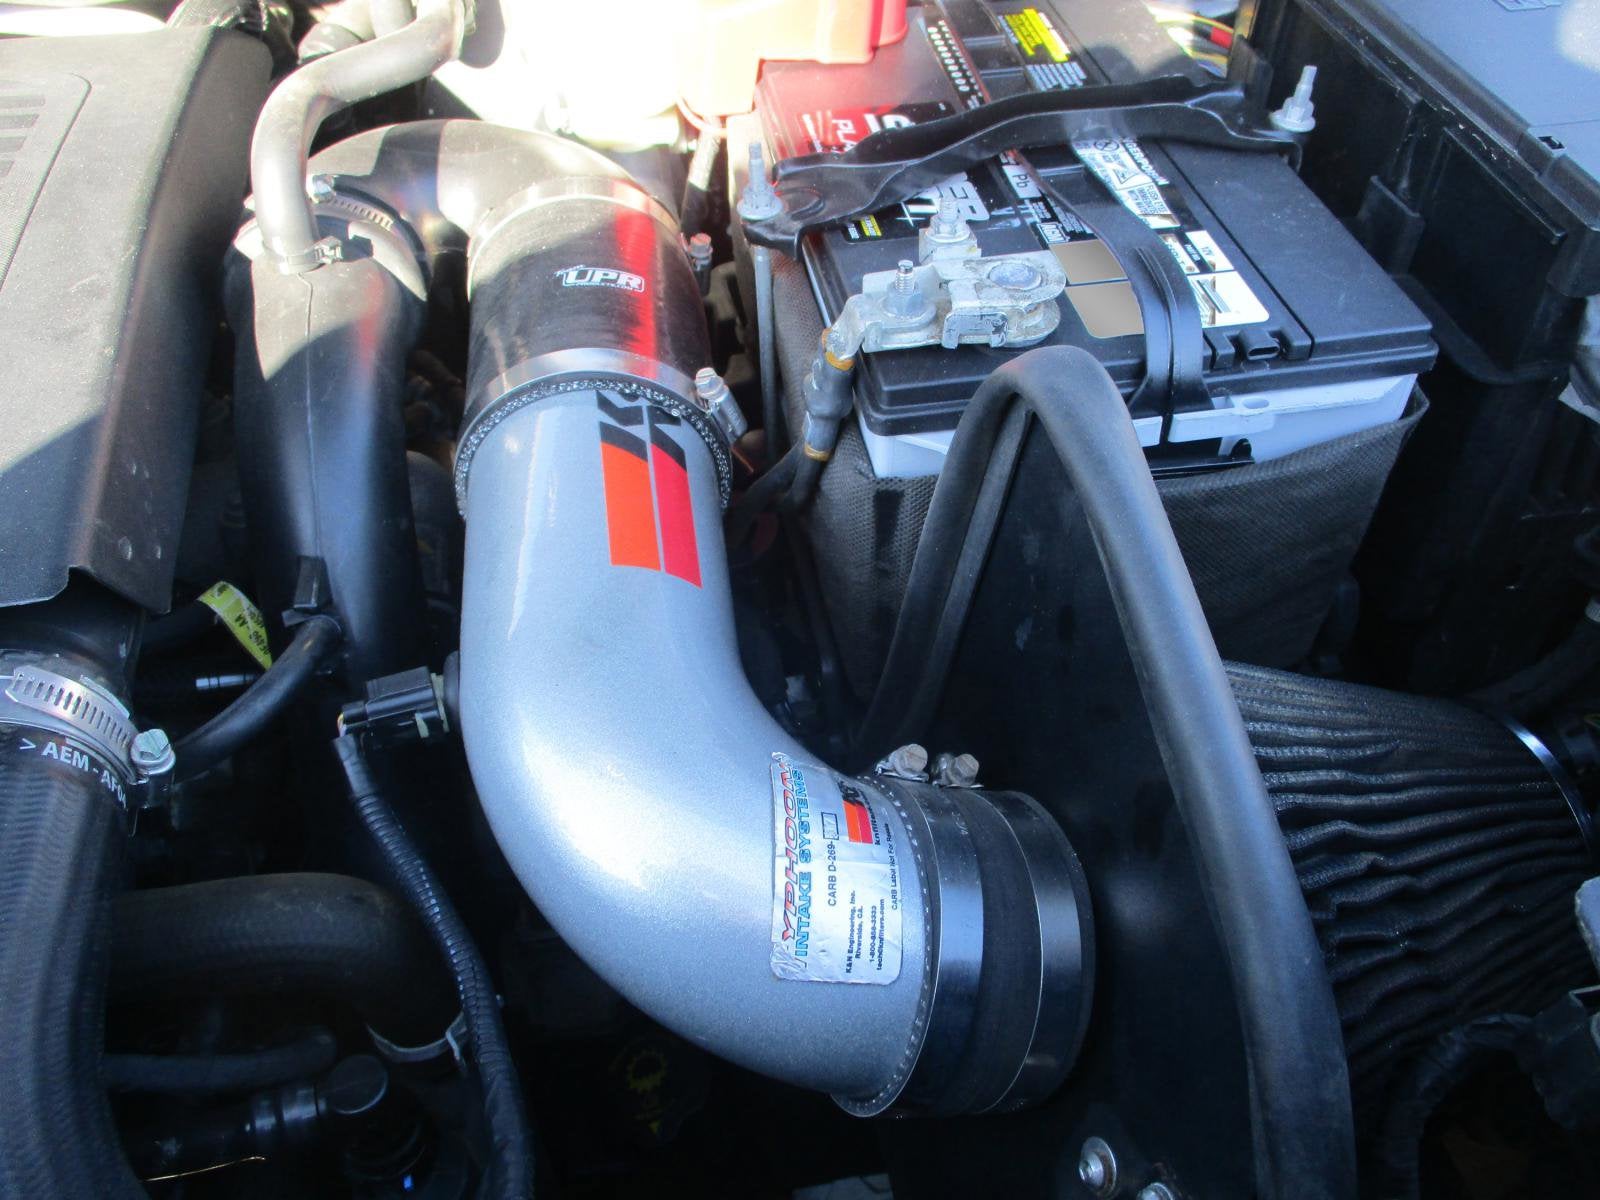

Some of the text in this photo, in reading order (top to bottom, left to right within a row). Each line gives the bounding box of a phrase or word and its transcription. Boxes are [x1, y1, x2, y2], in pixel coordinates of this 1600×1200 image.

[1012, 172, 1028, 188] Pb
[565, 268, 643, 290] UPR
[792, 767, 812, 958] INTAKE SYSTEMS
[827, 875, 837, 906] CARB
[848, 907, 856, 955] Engineering,
[855, 920, 863, 960] Riverside,
[845, 955, 853, 974] K&N
